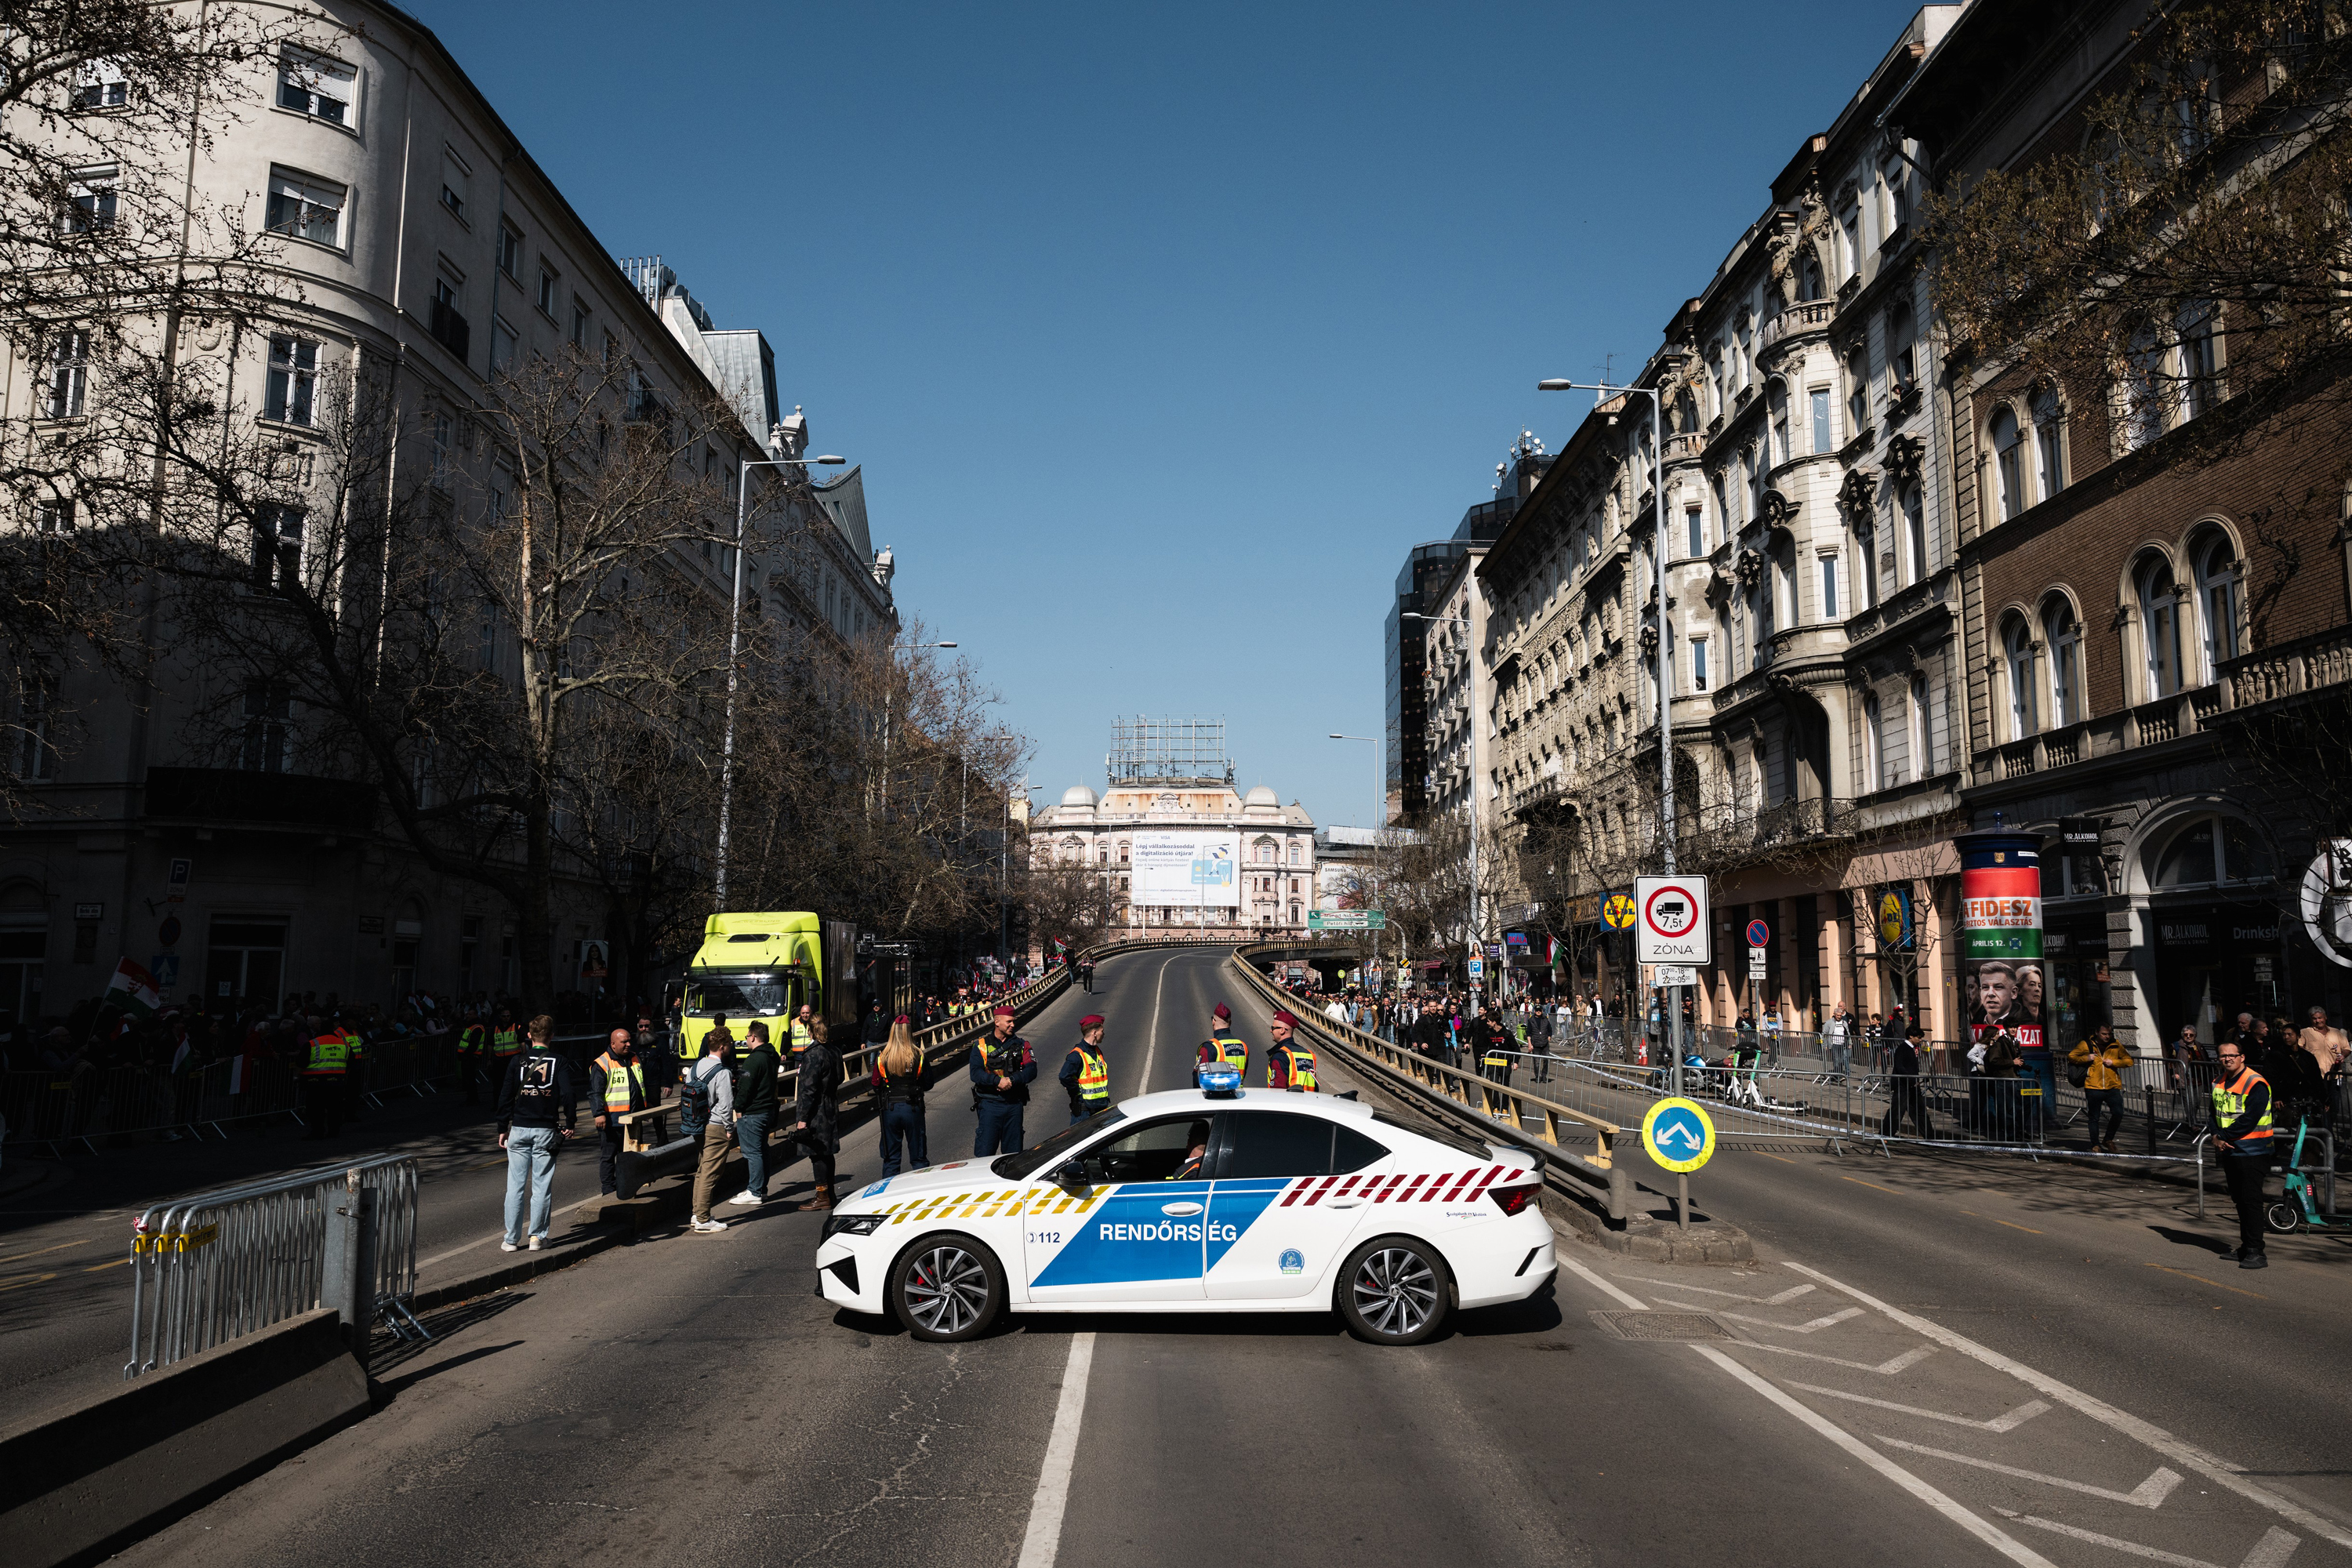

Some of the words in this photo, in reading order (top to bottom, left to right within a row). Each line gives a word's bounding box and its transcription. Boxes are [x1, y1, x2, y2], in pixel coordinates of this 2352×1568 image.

[1970, 899, 2032, 917] FIDESZ
[1662, 916, 1682, 928] 7,5t
[1966, 919, 1986, 927] BIZTOS
[1987, 916, 2033, 926] VÁLASZTÁS
[2161, 924, 2209, 940] MR.ALKOHOL
[1508, 934, 1527, 944] SKÁLA
[1653, 942, 1694, 955] ZÓNA
[1472, 962, 1479, 971] P
[1100, 1220, 1237, 1241] RENDŐRSÉG
[1039, 1232, 1060, 1243] 112
